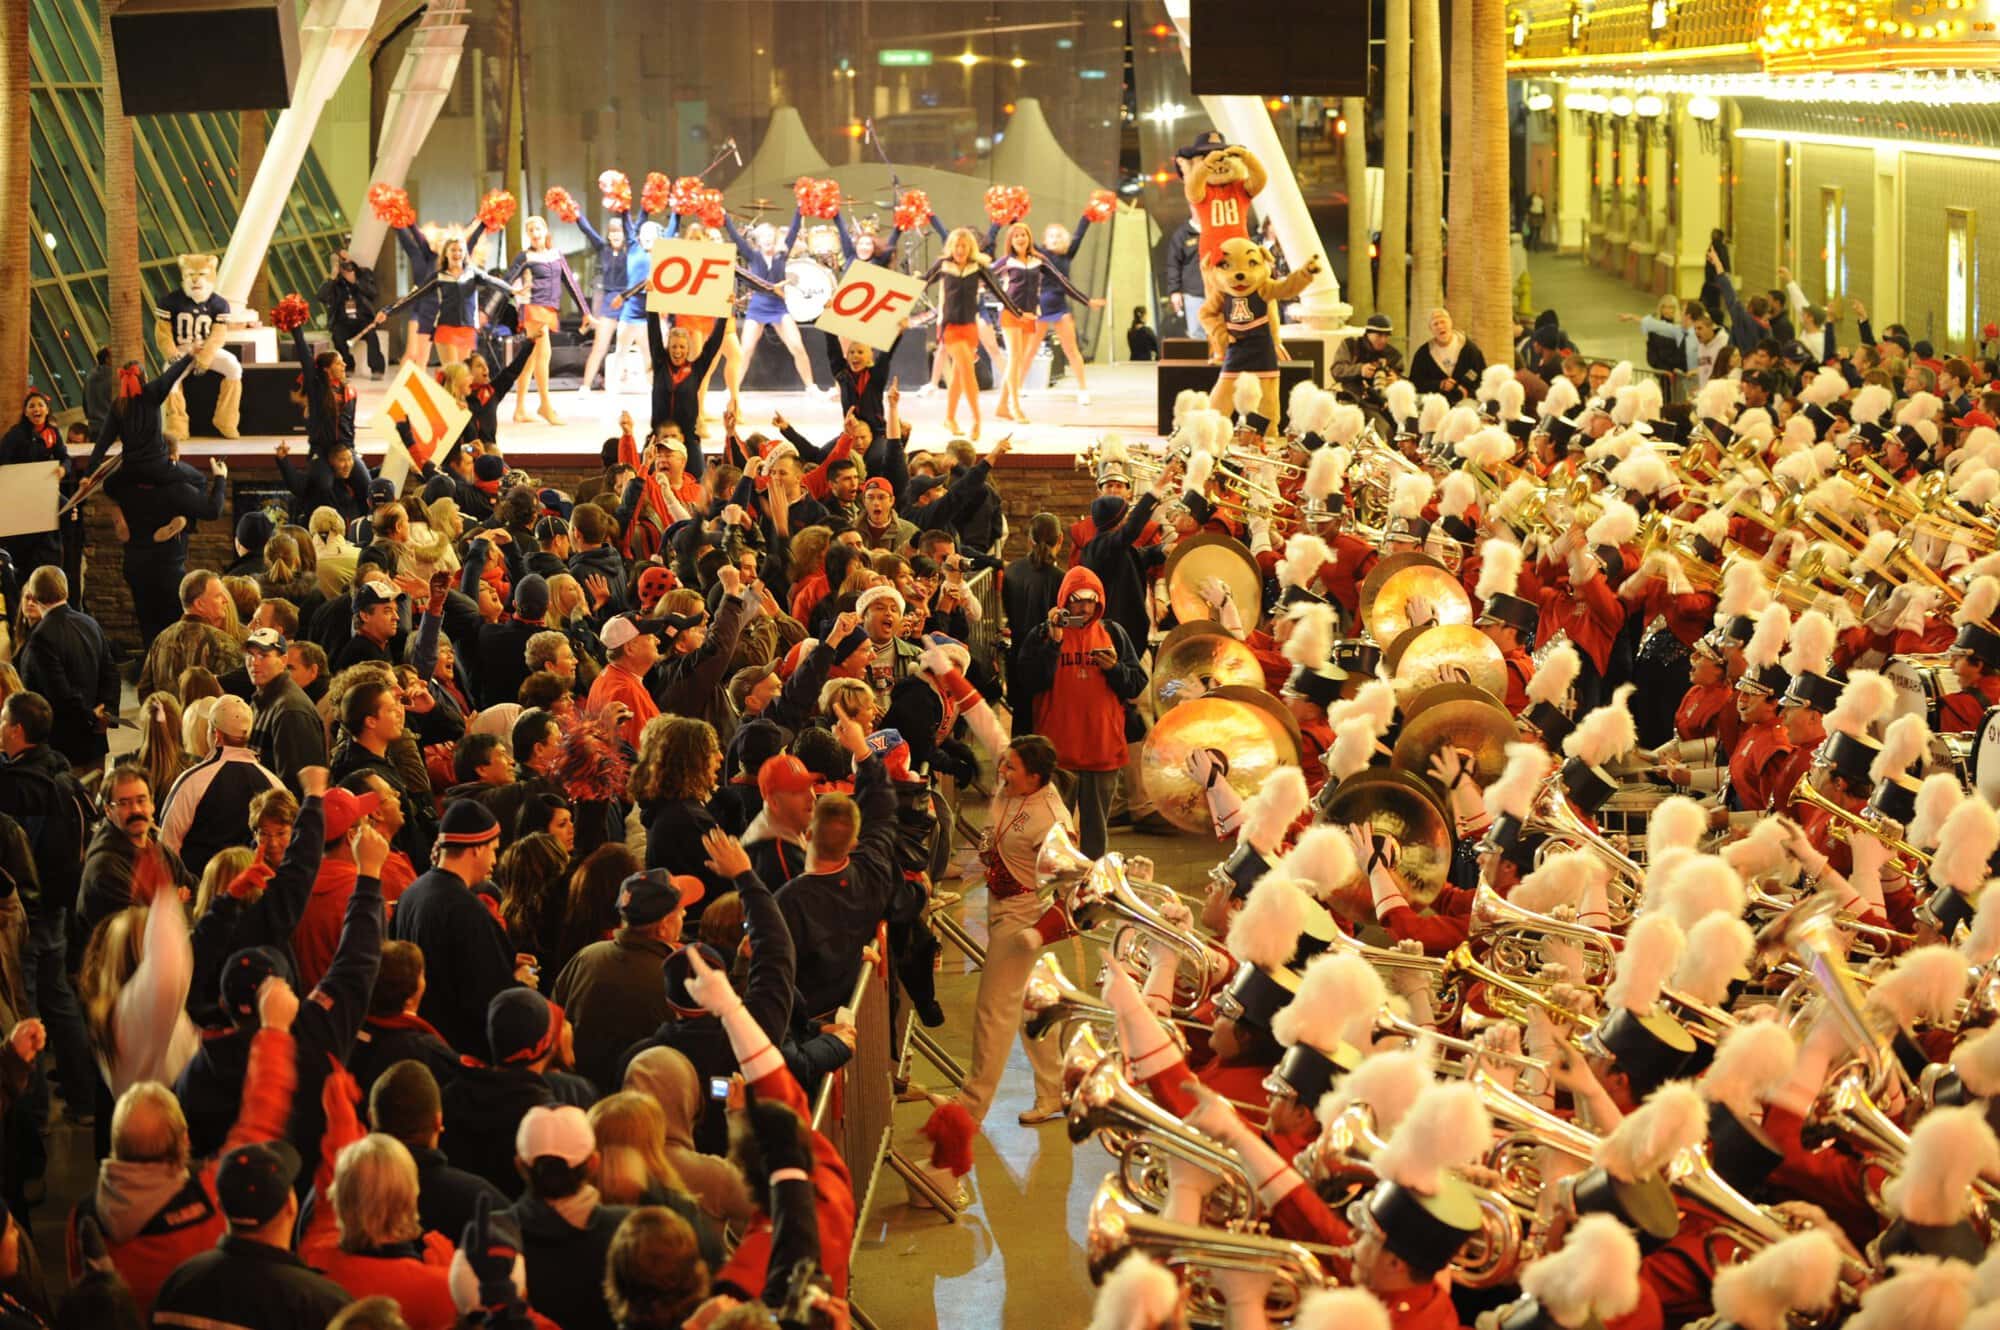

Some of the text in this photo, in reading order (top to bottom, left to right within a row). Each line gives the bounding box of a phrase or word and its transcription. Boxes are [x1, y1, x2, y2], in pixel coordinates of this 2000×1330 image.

[652, 256, 730, 296] OF
[832, 281, 913, 323] OF
[1230, 297, 1255, 323] A
[177, 312, 212, 345] 00
